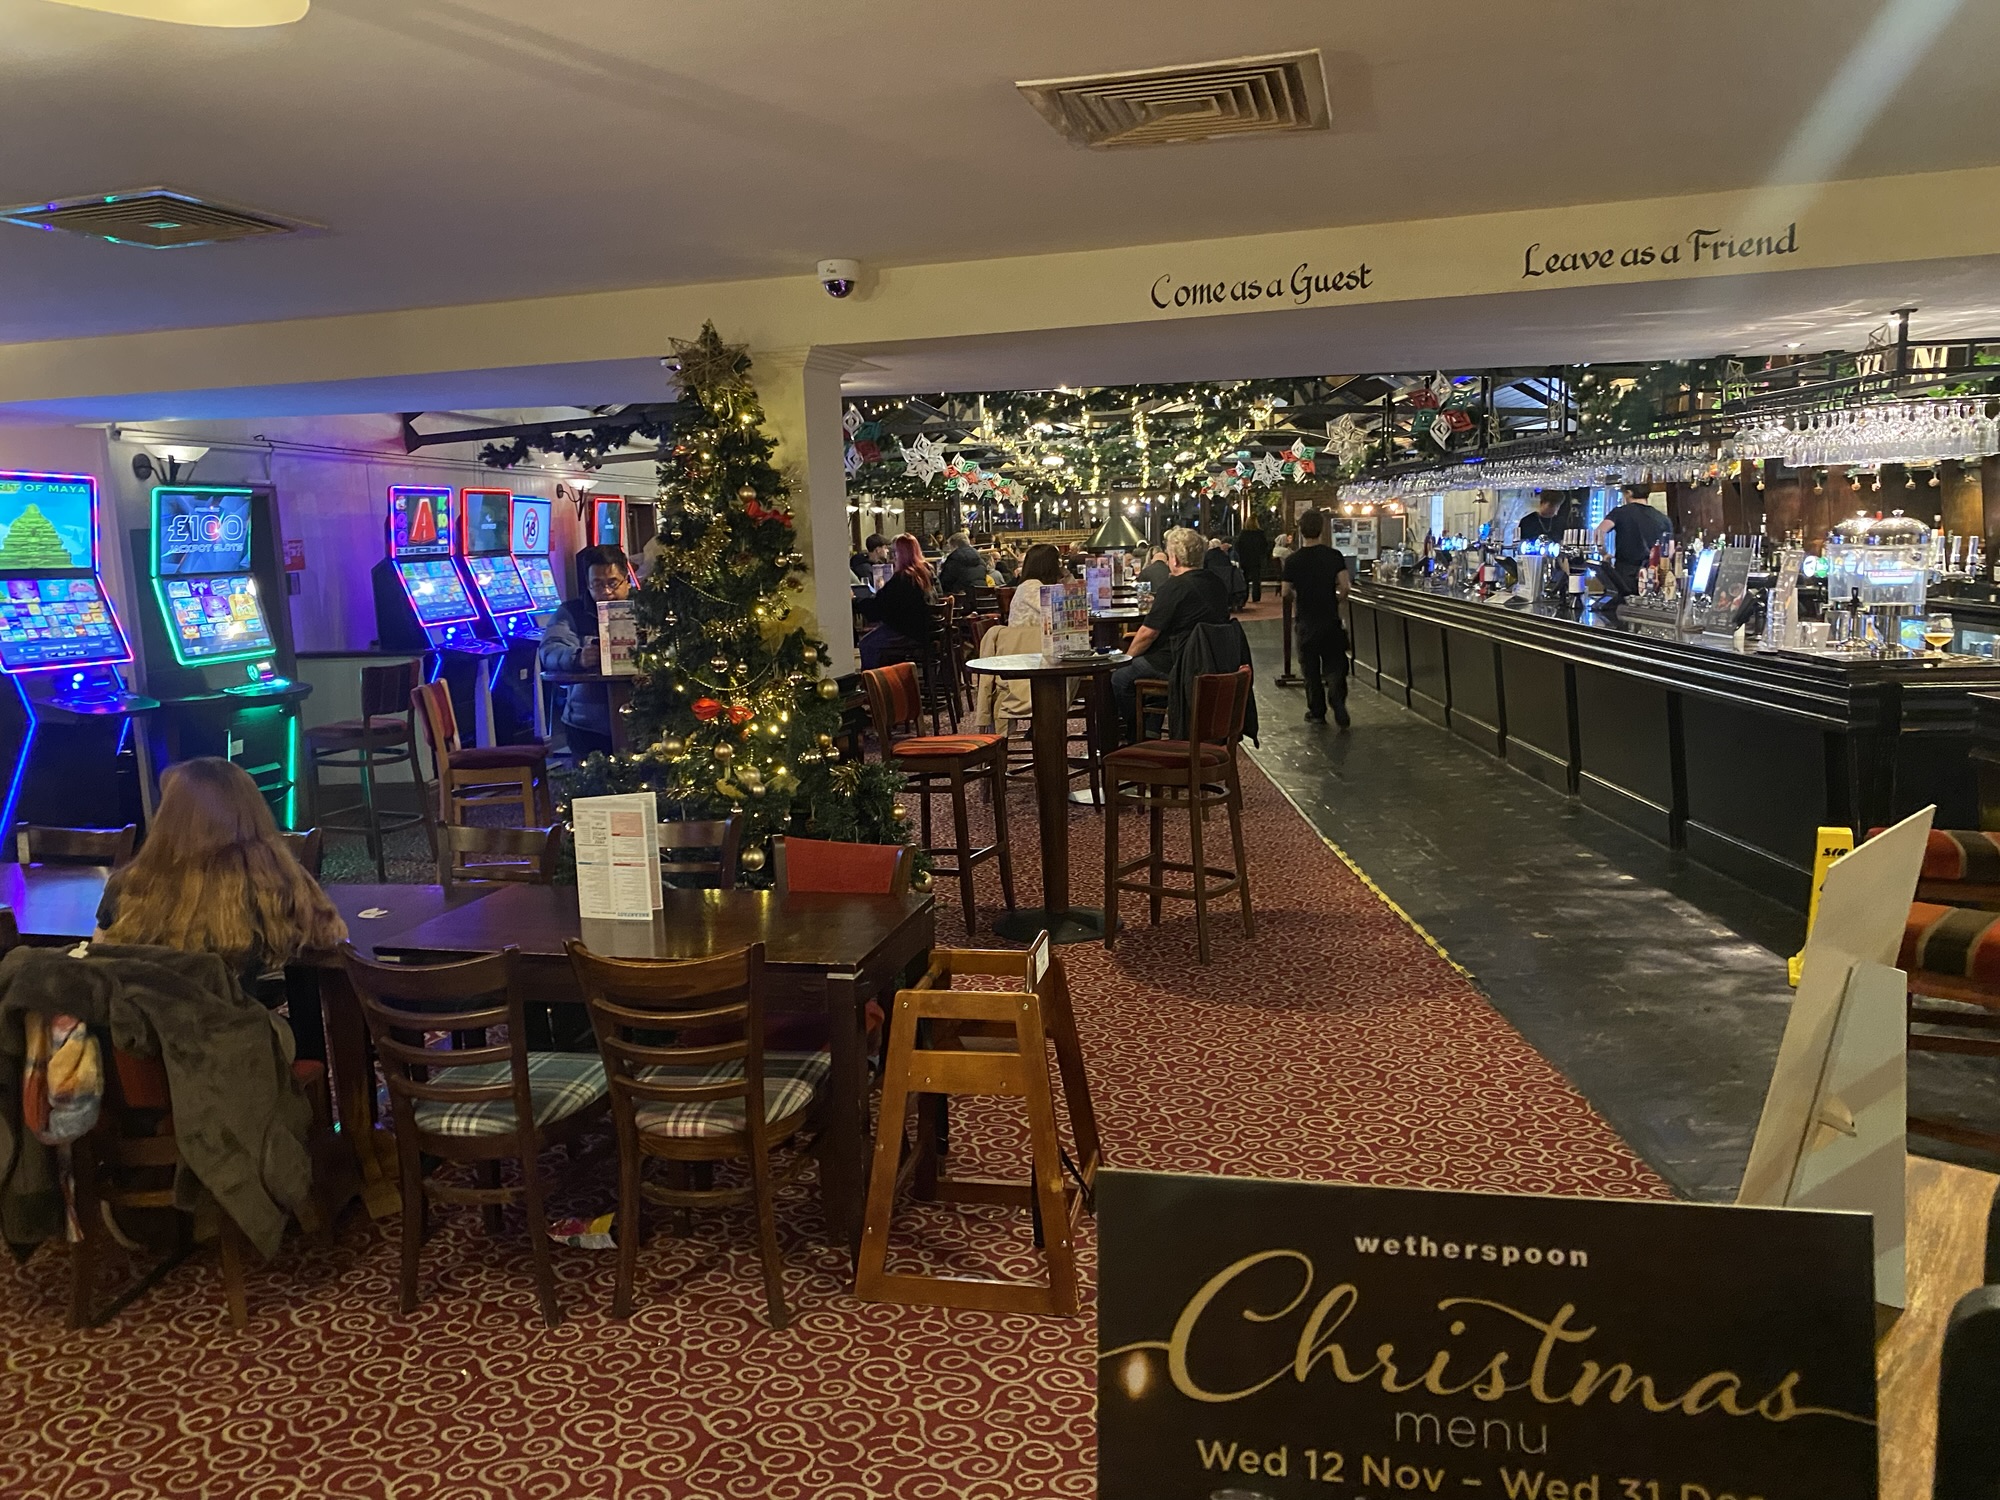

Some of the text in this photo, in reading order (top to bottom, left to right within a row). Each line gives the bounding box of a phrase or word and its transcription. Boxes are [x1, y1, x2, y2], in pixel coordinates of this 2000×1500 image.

[1522, 222, 1799, 278] Leave as a Friend
[1151, 262, 1373, 309] Come as a Guest
[24, 484, 43, 492] OF
[48, 484, 86, 494] MAYA
[167, 514, 243, 542] £100
[526, 521, 536, 537] 18
[1354, 1235, 1589, 1268] wetherspoon
[1166, 1249, 1806, 1421] Christmas
[1395, 1411, 1547, 1454] menu
[1196, 1439, 1288, 1477] Wed
[1304, 1449, 1345, 1483] 12
[1362, 1454, 1446, 1493] Nov
[1500, 1465, 1599, 1500] Wed
